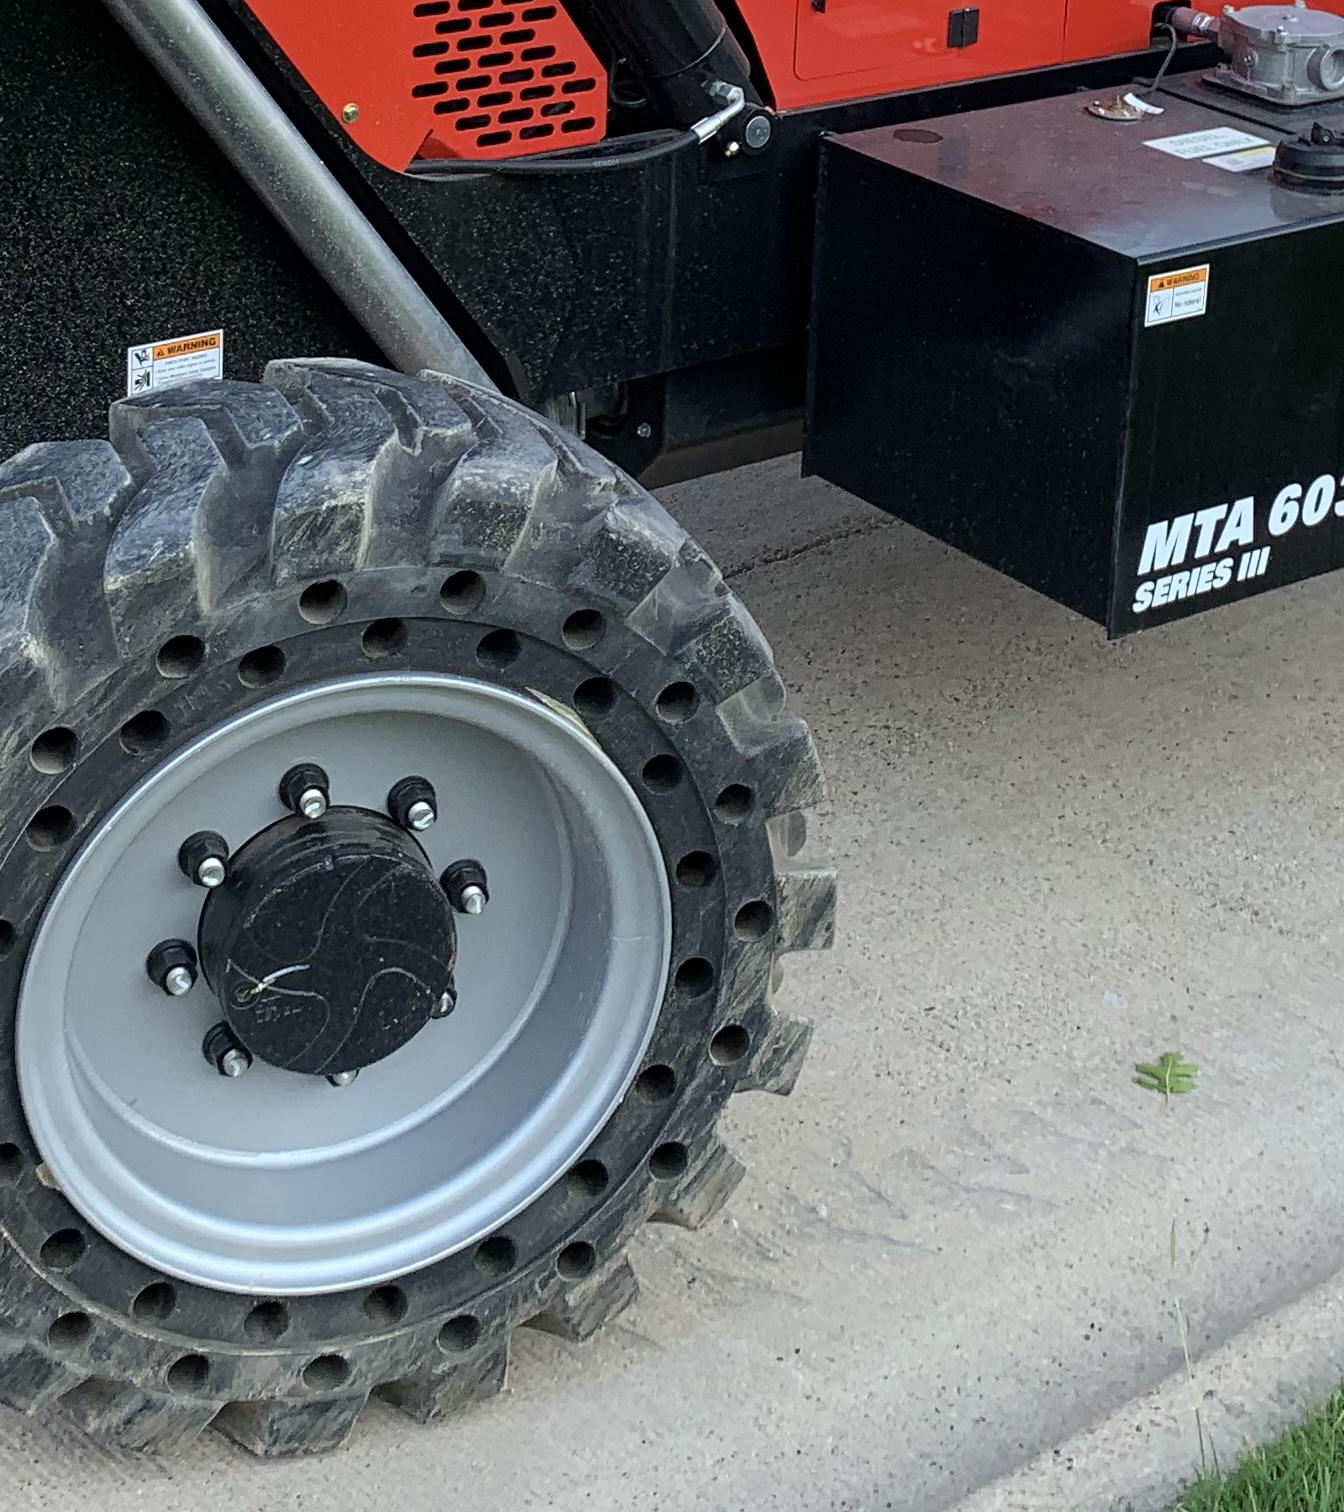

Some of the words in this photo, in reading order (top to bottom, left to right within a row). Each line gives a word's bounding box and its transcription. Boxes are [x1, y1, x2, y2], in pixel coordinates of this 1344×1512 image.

[167, 337, 216, 355] WARNING
[1137, 496, 1254, 576] MTA
[1132, 557, 1234, 614] SERIES
[1236, 546, 1271, 582] III
